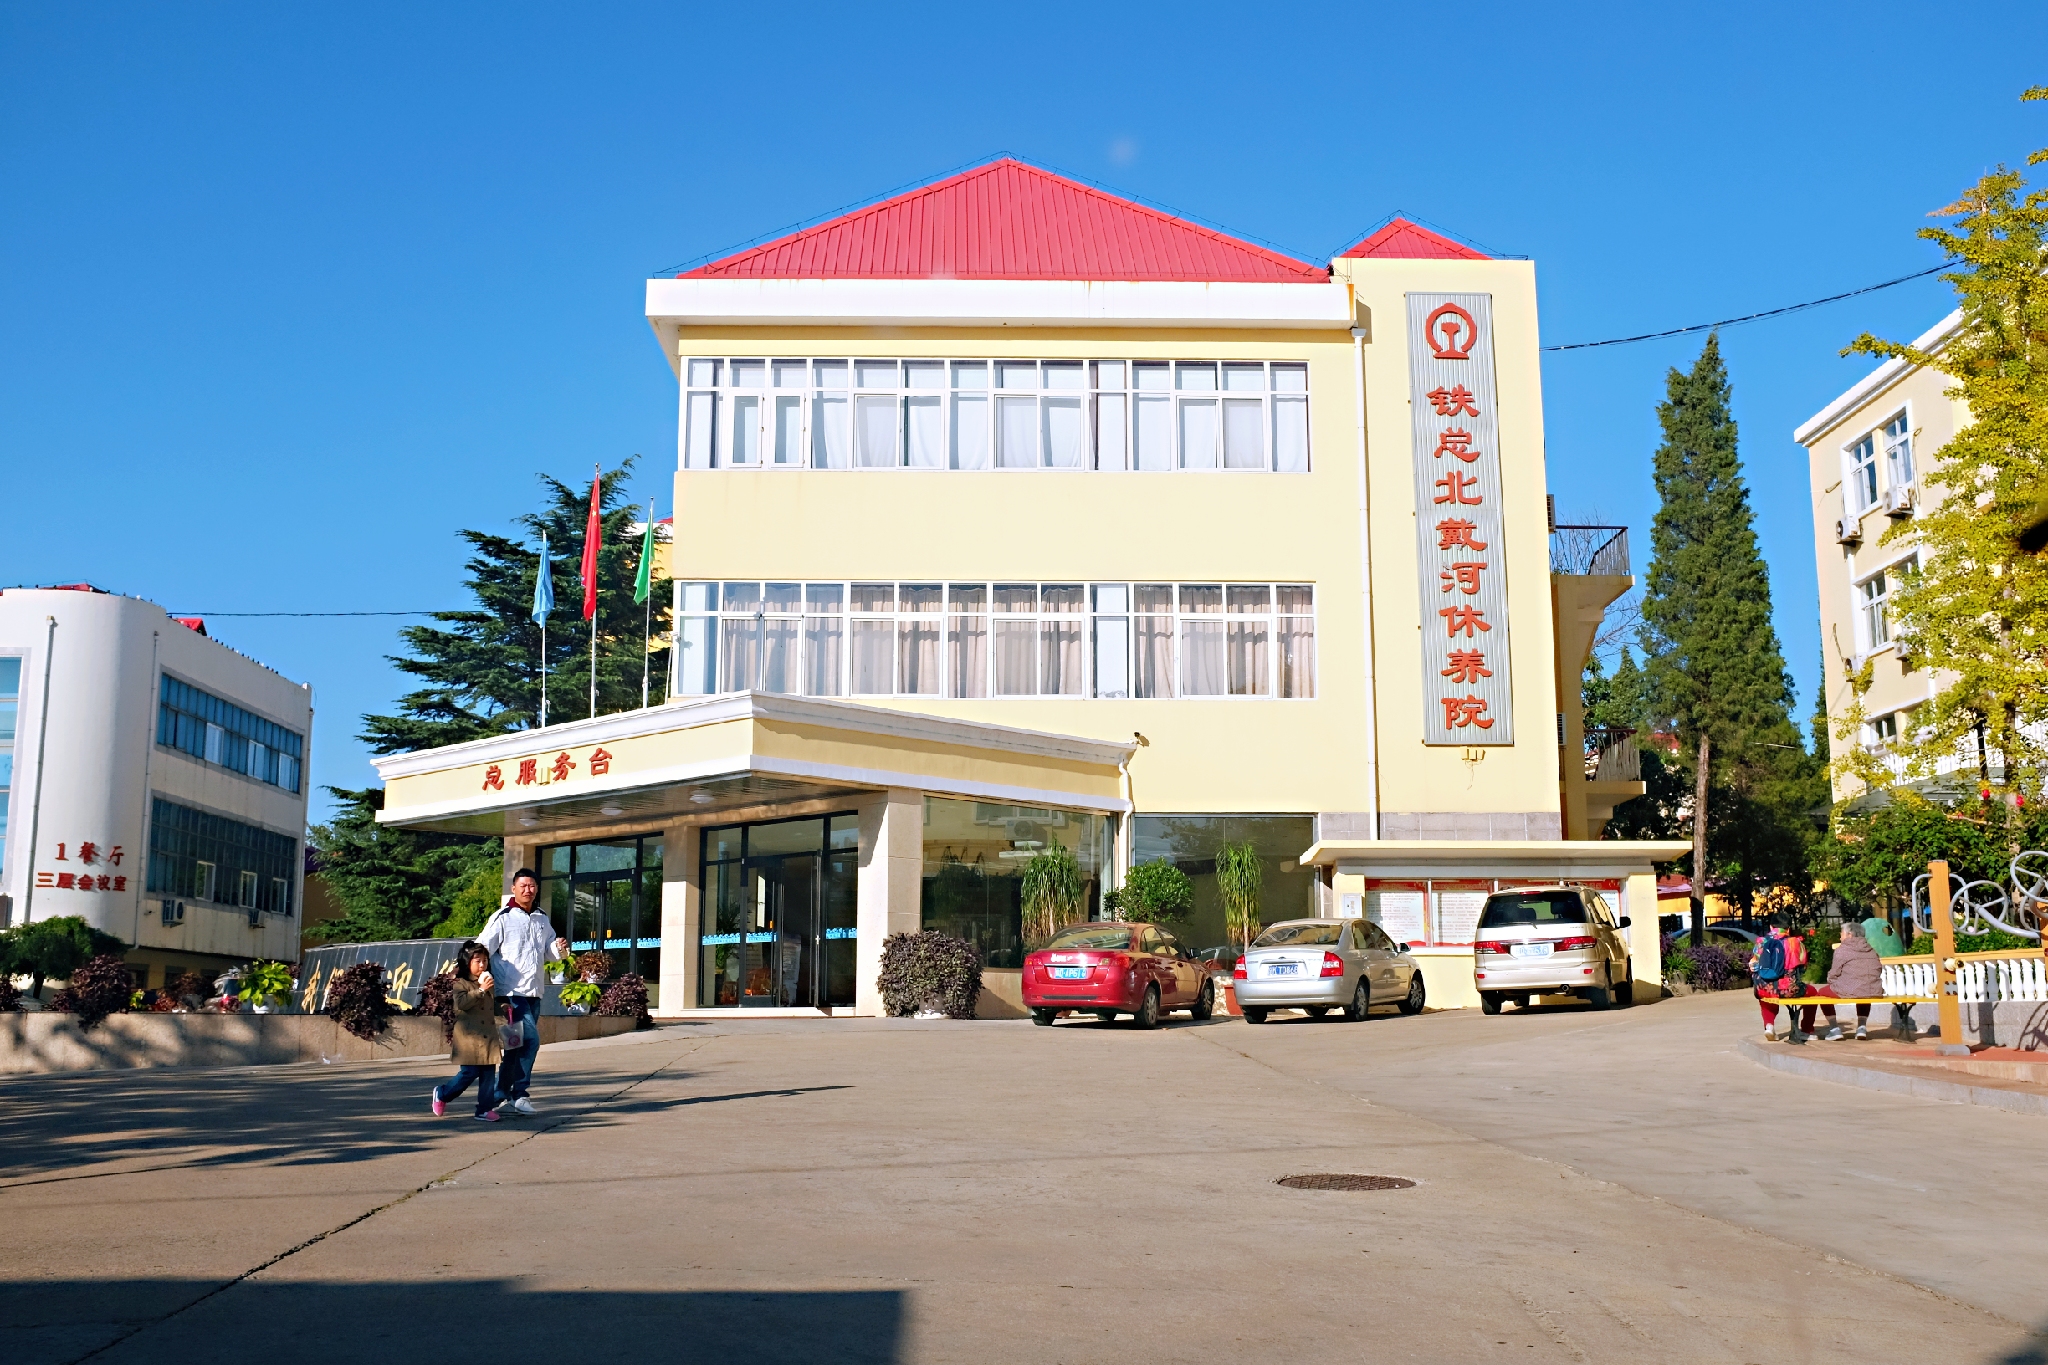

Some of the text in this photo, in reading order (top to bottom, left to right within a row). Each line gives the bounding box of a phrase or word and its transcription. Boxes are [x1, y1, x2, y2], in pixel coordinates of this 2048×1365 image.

[1426, 383, 1495, 730] 铁总北戴河休养院
[482, 747, 613, 791] 总服务台
